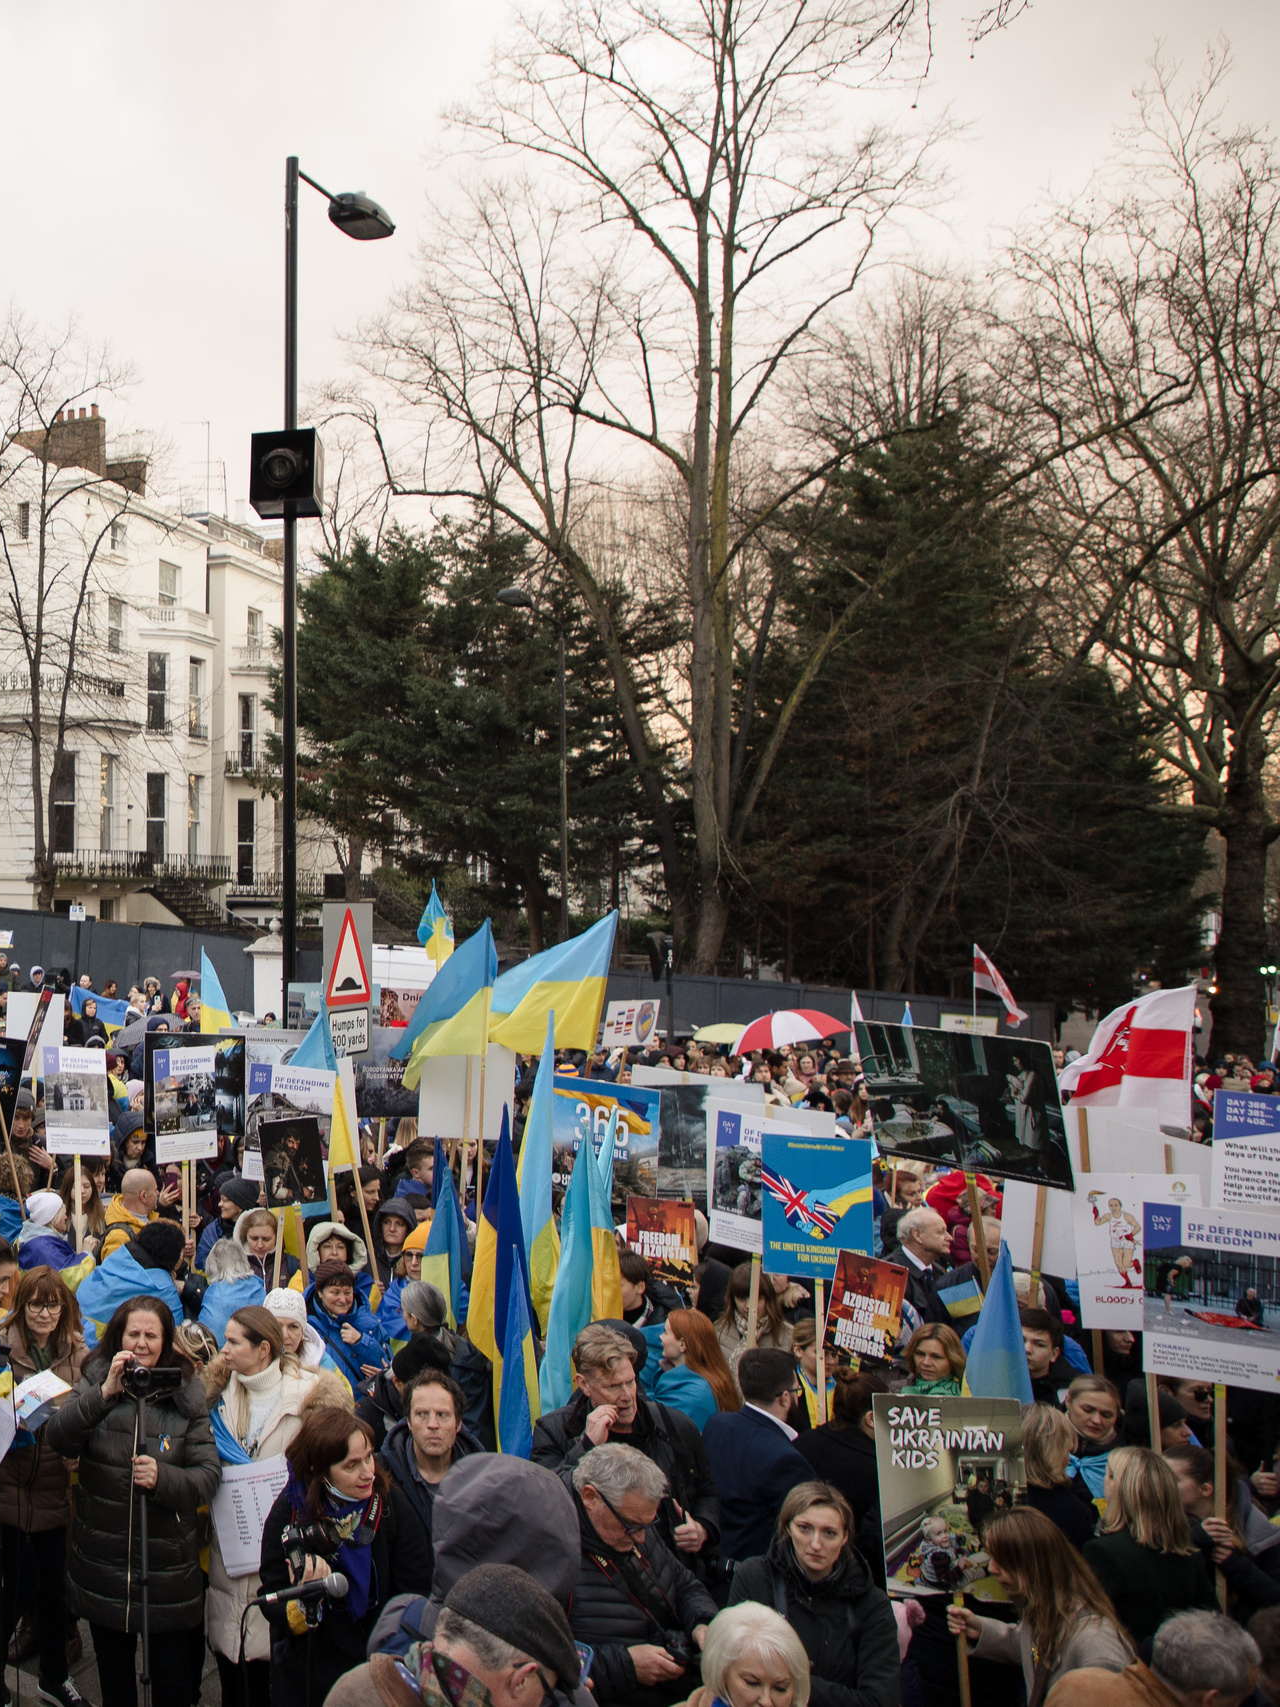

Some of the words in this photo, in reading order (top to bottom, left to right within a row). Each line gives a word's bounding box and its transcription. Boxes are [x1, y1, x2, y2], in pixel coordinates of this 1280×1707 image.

[332, 1019, 354, 1032] Humps
[356, 1016, 365, 1028] for
[332, 1034, 346, 1047] 500
[348, 1032, 365, 1048] yards
[275, 1083, 310, 1092] FREEDOM
[287, 1078, 330, 1088] DEFENDING
[1226, 1099, 1246, 1107] DAY
[1226, 1106, 1246, 1115] DAY
[722, 1120, 735, 1128] DAY
[1225, 1114, 1246, 1123] DAY
[575, 1103, 629, 1147] 365
[1225, 1142, 1248, 1151] What
[1250, 1145, 1267, 1153] will
[1225, 1150, 1245, 1158] days
[1224, 1165, 1239, 1173] You
[1241, 1167, 1262, 1176] have
[1264, 1170, 1279, 1178] the
[1224, 1173, 1266, 1184] influence
[1223, 1182, 1242, 1190] Help
[1223, 1189, 1243, 1197] free
[1245, 1192, 1271, 1201] world
[1151, 1215, 1172, 1224] DAY
[1153, 1222, 1171, 1231] 147
[1188, 1223, 1205, 1232] OF
[1209, 1226, 1280, 1241] DEFENDIN
[639, 1230, 680, 1246] FREEDOM
[1188, 1232, 1253, 1248] FREEDOM
[630, 1241, 642, 1255] TO
[643, 1243, 690, 1261] AZOVSTAL
[769, 1241, 781, 1250] THE
[782, 1242, 805, 1252] UNITED
[806, 1244, 835, 1255] KINGDOM
[797, 1254, 809, 1262] FOR
[842, 1290, 890, 1317] AZOVSTAL
[1095, 1296, 1134, 1304] BLOODY
[853, 1307, 874, 1326] FREE
[836, 1317, 885, 1344] MARIUPOL
[833, 1331, 885, 1358] DEFENDERS
[1152, 1342, 1190, 1352] /KHARKIV
[888, 1406, 941, 1428] SAVE
[890, 1427, 1004, 1453] UKRAINIAN
[891, 1448, 939, 1470] KIDS
